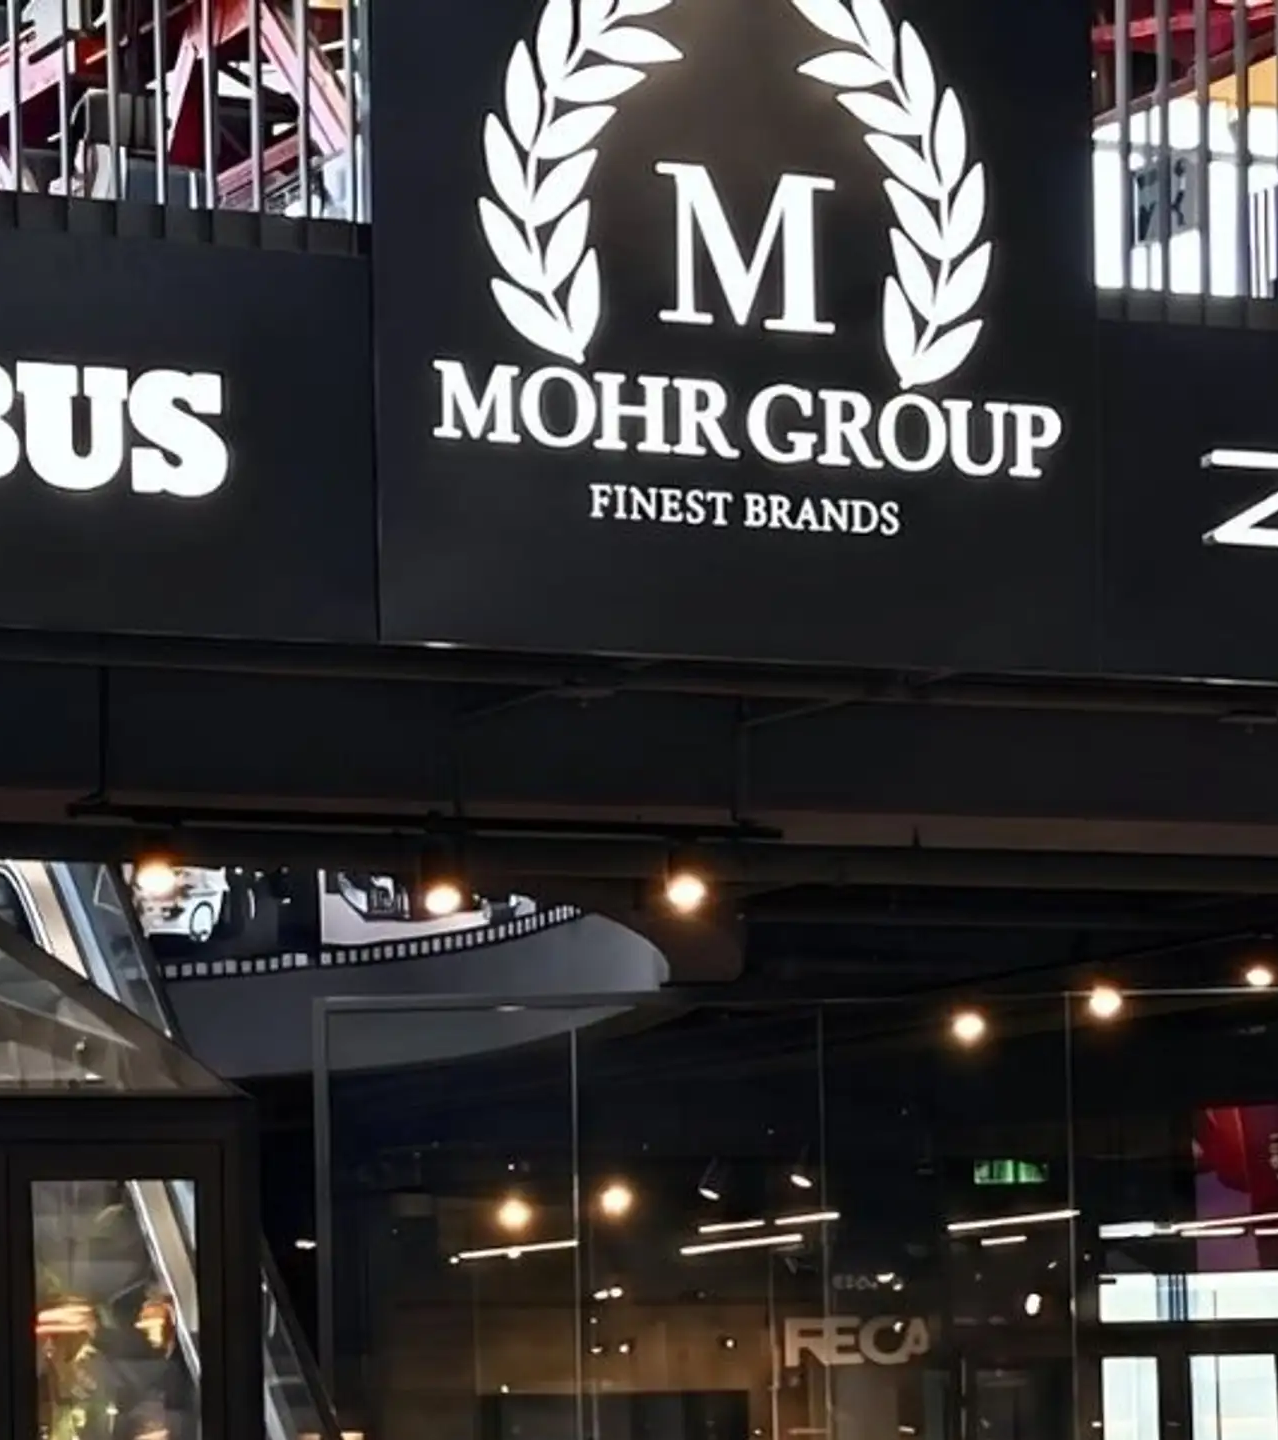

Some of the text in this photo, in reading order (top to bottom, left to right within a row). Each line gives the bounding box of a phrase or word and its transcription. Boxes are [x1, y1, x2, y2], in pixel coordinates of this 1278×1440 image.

[655, 160, 836, 335] M
[433, 358, 1063, 479] MOHR GROUP
[589, 484, 901, 536] FINEST BRANDS
